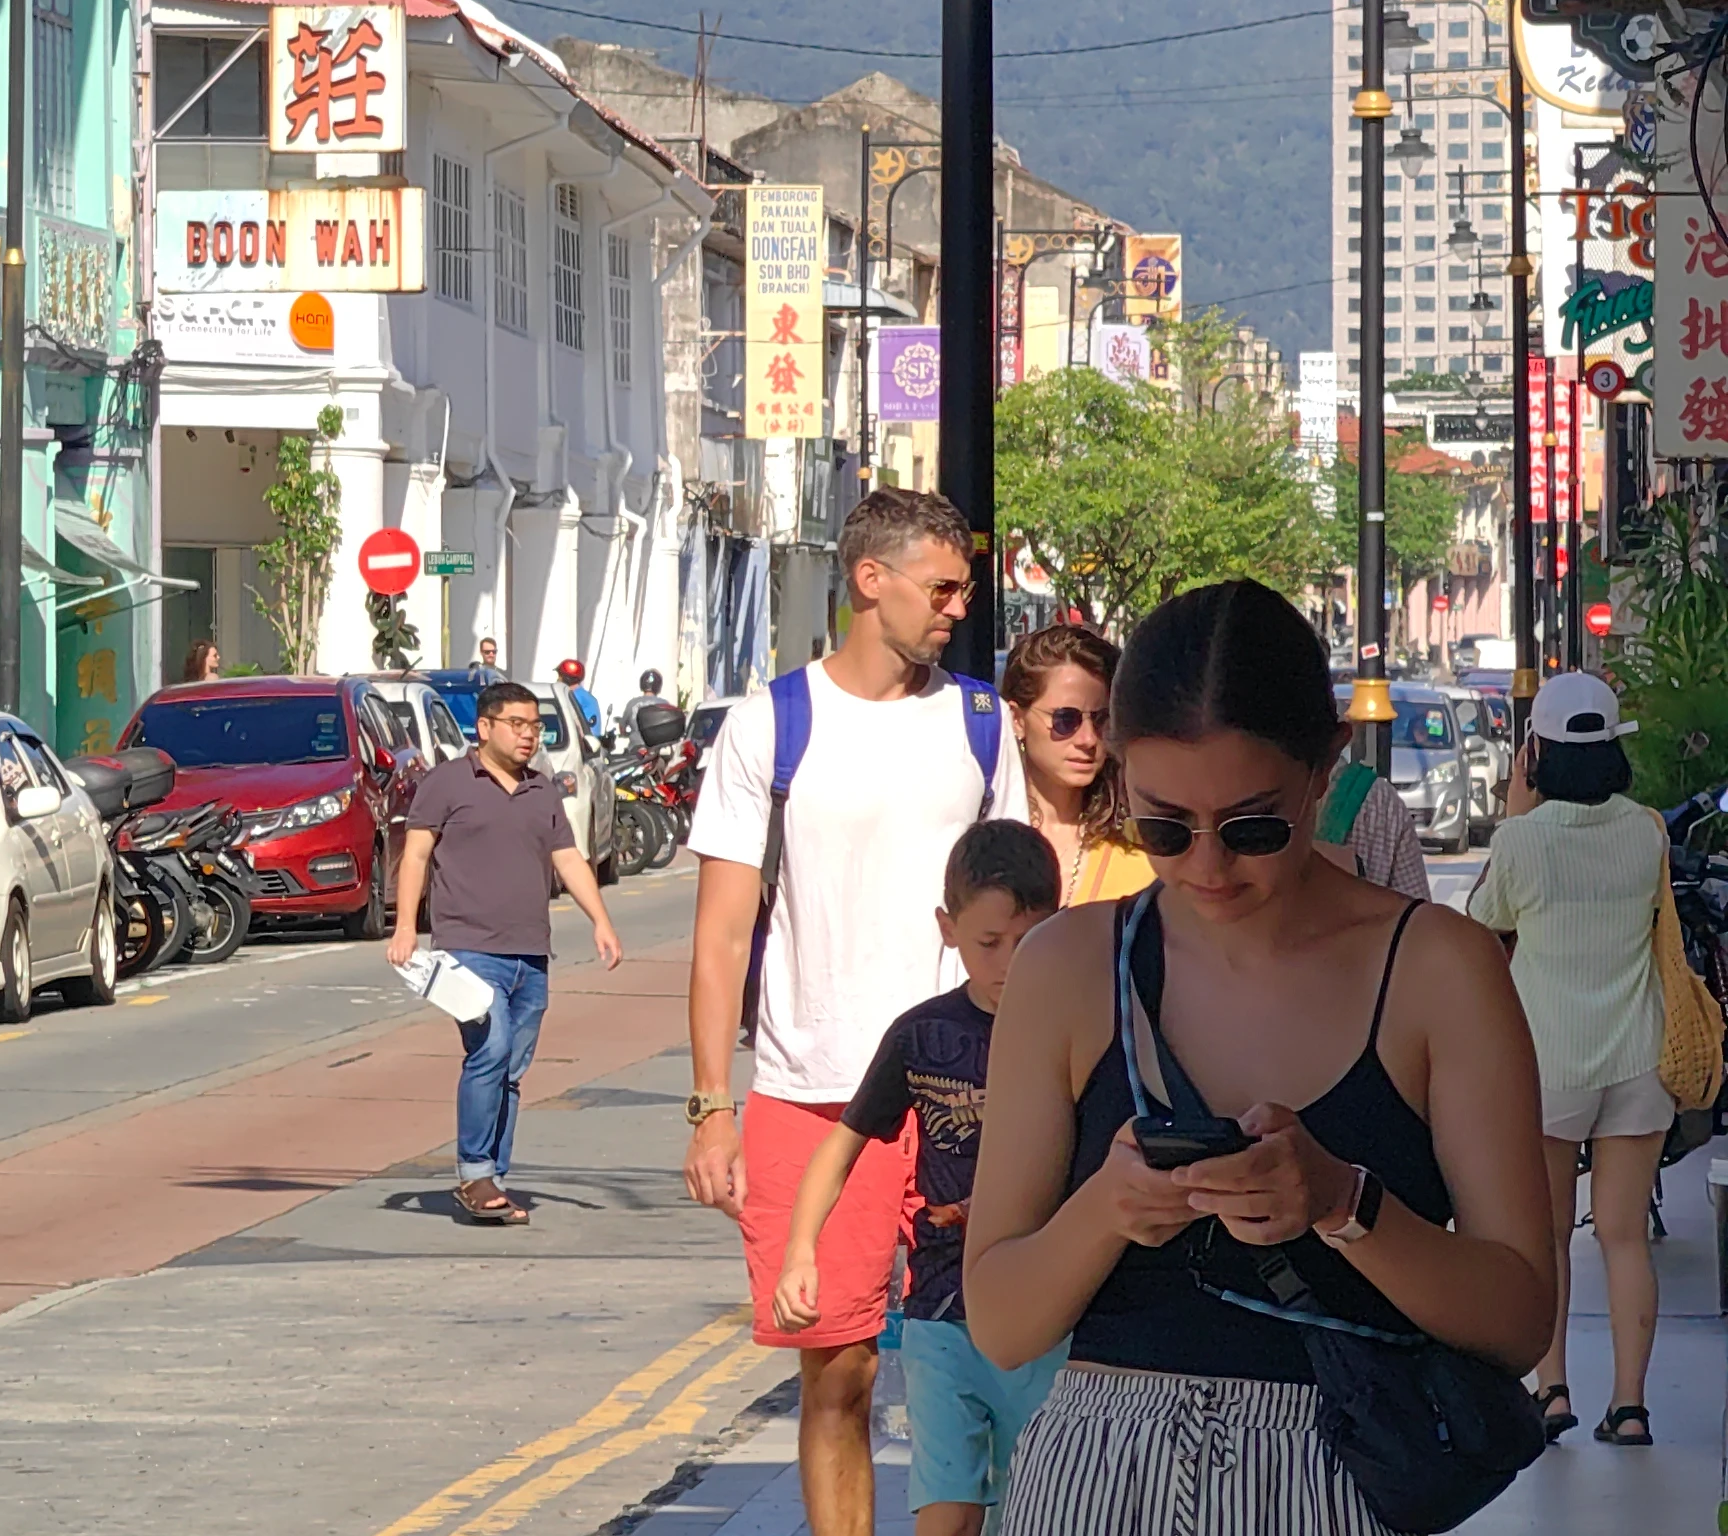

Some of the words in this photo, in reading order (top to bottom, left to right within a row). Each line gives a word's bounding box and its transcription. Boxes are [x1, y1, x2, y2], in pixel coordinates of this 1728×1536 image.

[753, 190, 818, 203] PEMBORONG
[761, 205, 809, 218] PAKAIAN
[752, 221, 775, 234] DAN
[780, 221, 817, 234] TUALA
[1558, 181, 1656, 270] Tig
[186, 220, 287, 269] BOON
[315, 218, 391, 268] WAH
[752, 236, 817, 262] DONGFAH
[759, 264, 783, 280] SDN
[787, 264, 811, 280] BHD
[757, 281, 810, 295] (BRANCH)
[178, 323, 233, 337] Connecting
[236, 325, 251, 336] for
[254, 327, 272, 337] Life
[764, 302, 806, 395] 東發
[907, 362, 931, 380] SF
[1600, 371, 1611, 388] 3
